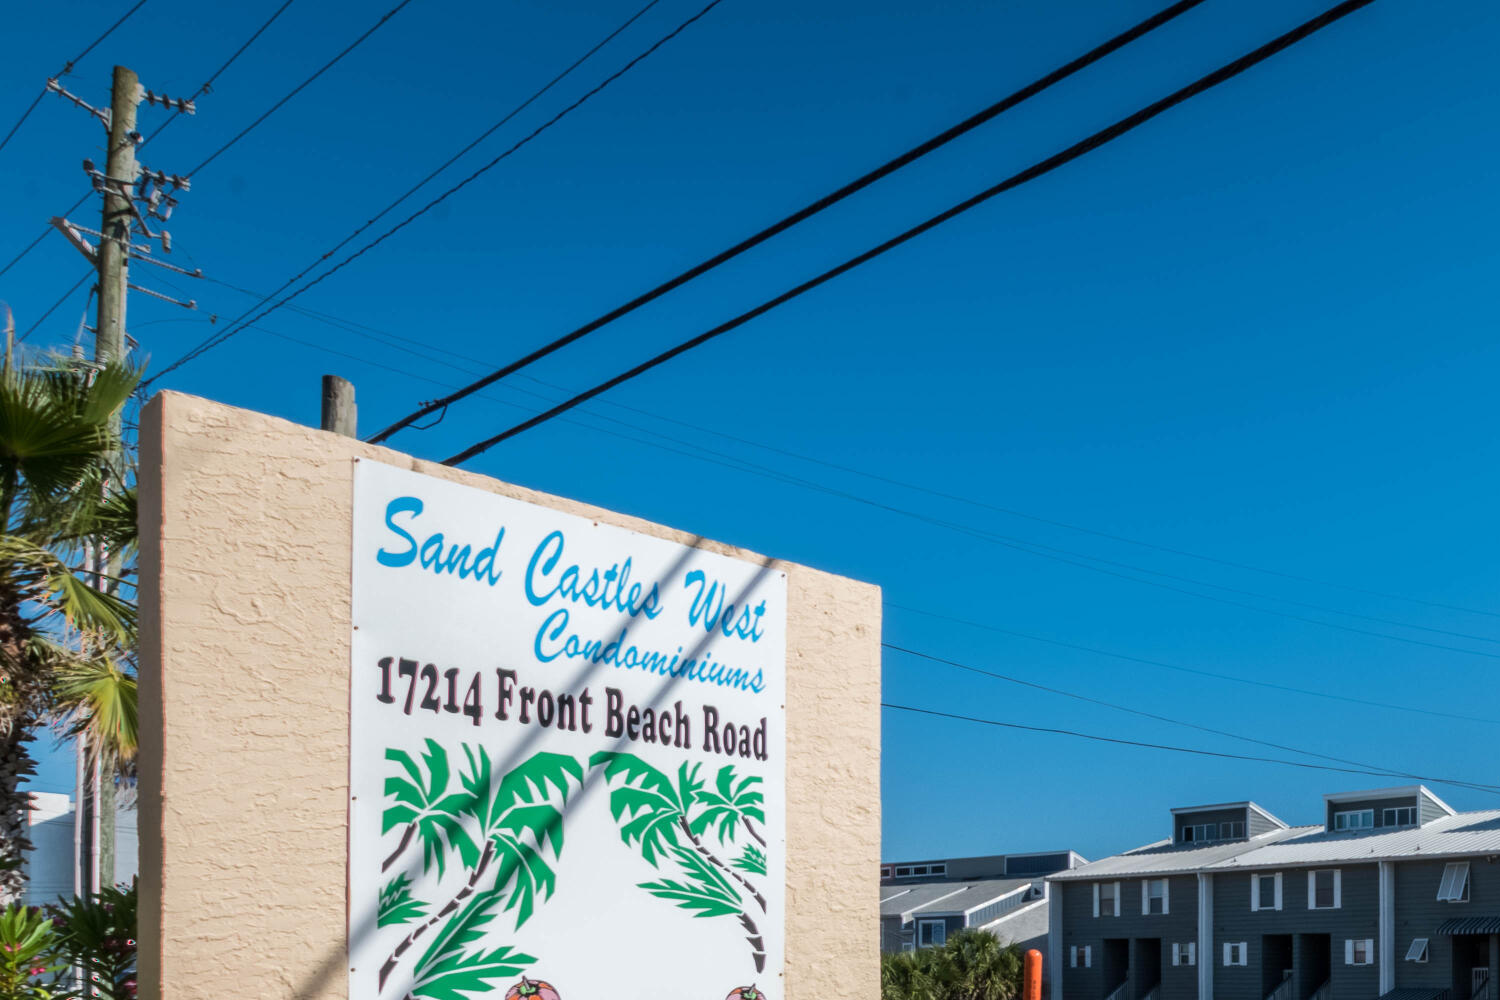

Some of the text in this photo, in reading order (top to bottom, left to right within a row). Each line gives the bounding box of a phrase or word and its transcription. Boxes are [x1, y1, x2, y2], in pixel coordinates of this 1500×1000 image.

[376, 496, 767, 643] Sand Castles West
[534, 608, 766, 694] Condominiums
[376, 656, 769, 762] 17214 Front Beach Road
